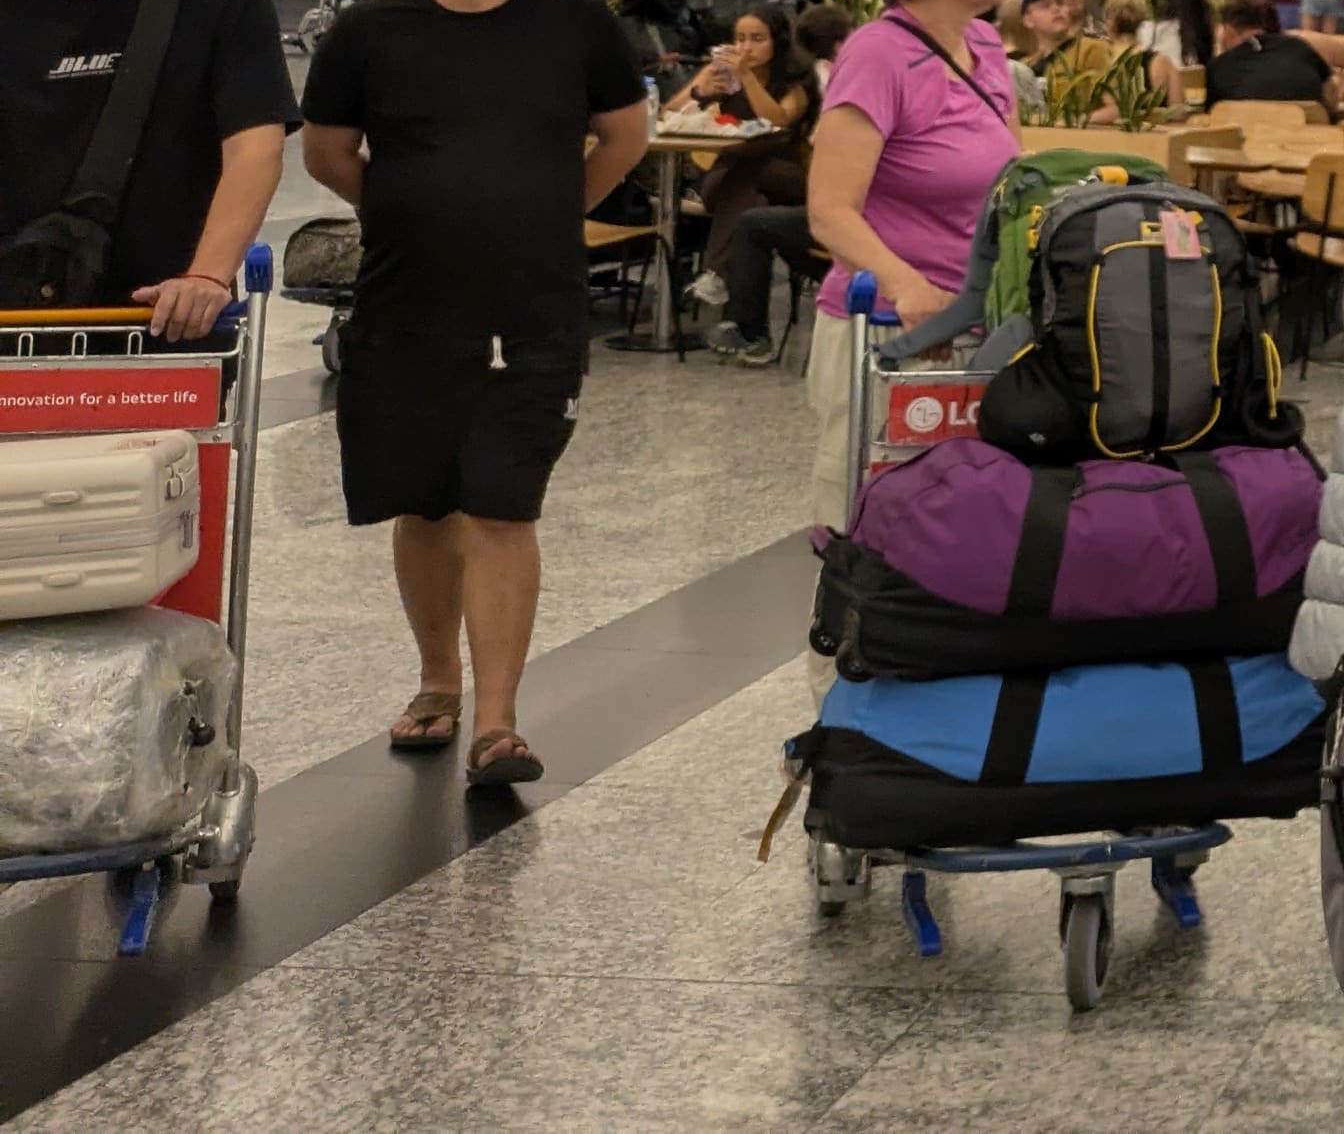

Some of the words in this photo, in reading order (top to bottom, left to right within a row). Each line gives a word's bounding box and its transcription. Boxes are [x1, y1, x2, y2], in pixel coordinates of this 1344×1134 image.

[0, 394, 74, 407] nnovation
[80, 392, 102, 405] for
[107, 395, 116, 405] a
[121, 391, 168, 404] better
[174, 390, 197, 403] life
